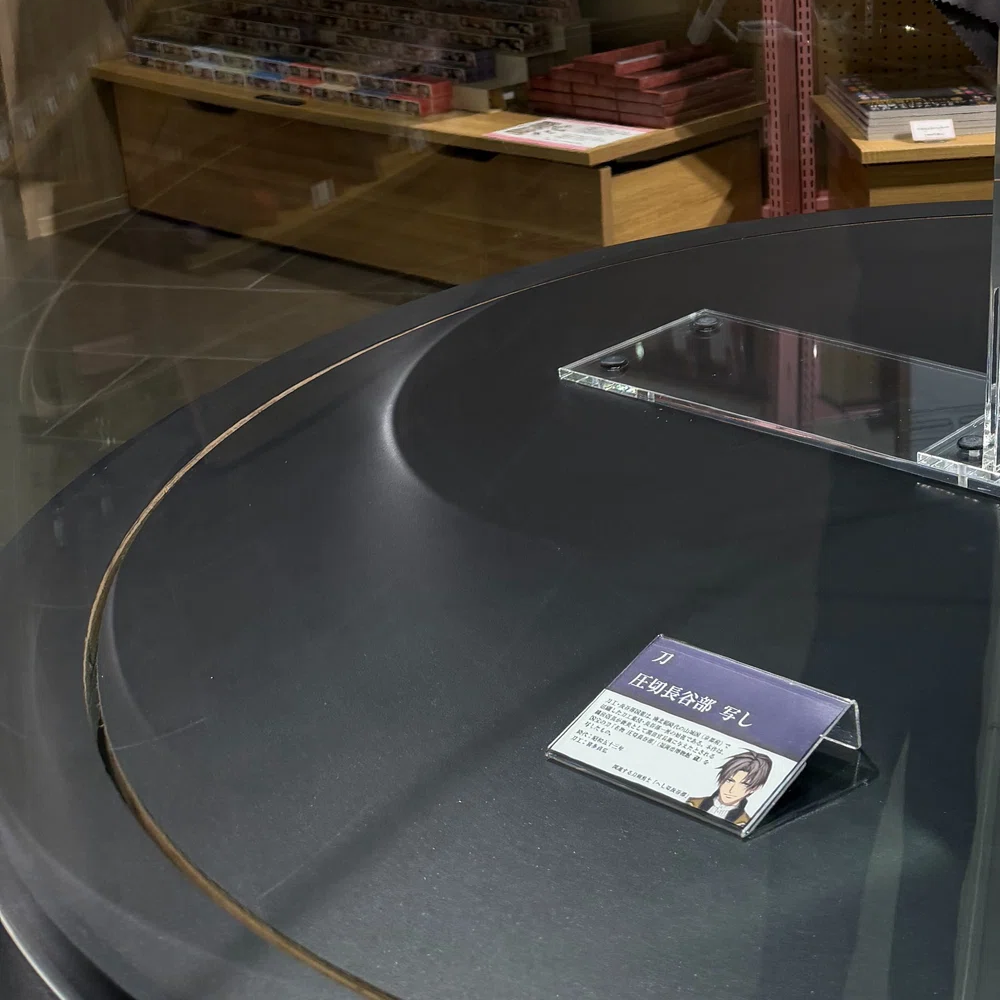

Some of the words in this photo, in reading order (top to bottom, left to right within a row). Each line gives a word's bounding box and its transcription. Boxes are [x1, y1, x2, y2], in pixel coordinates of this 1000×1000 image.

[651, 650, 675, 665] 刀
[628, 673, 717, 712] 圧切長谷部
[720, 706, 752, 727] 写し
